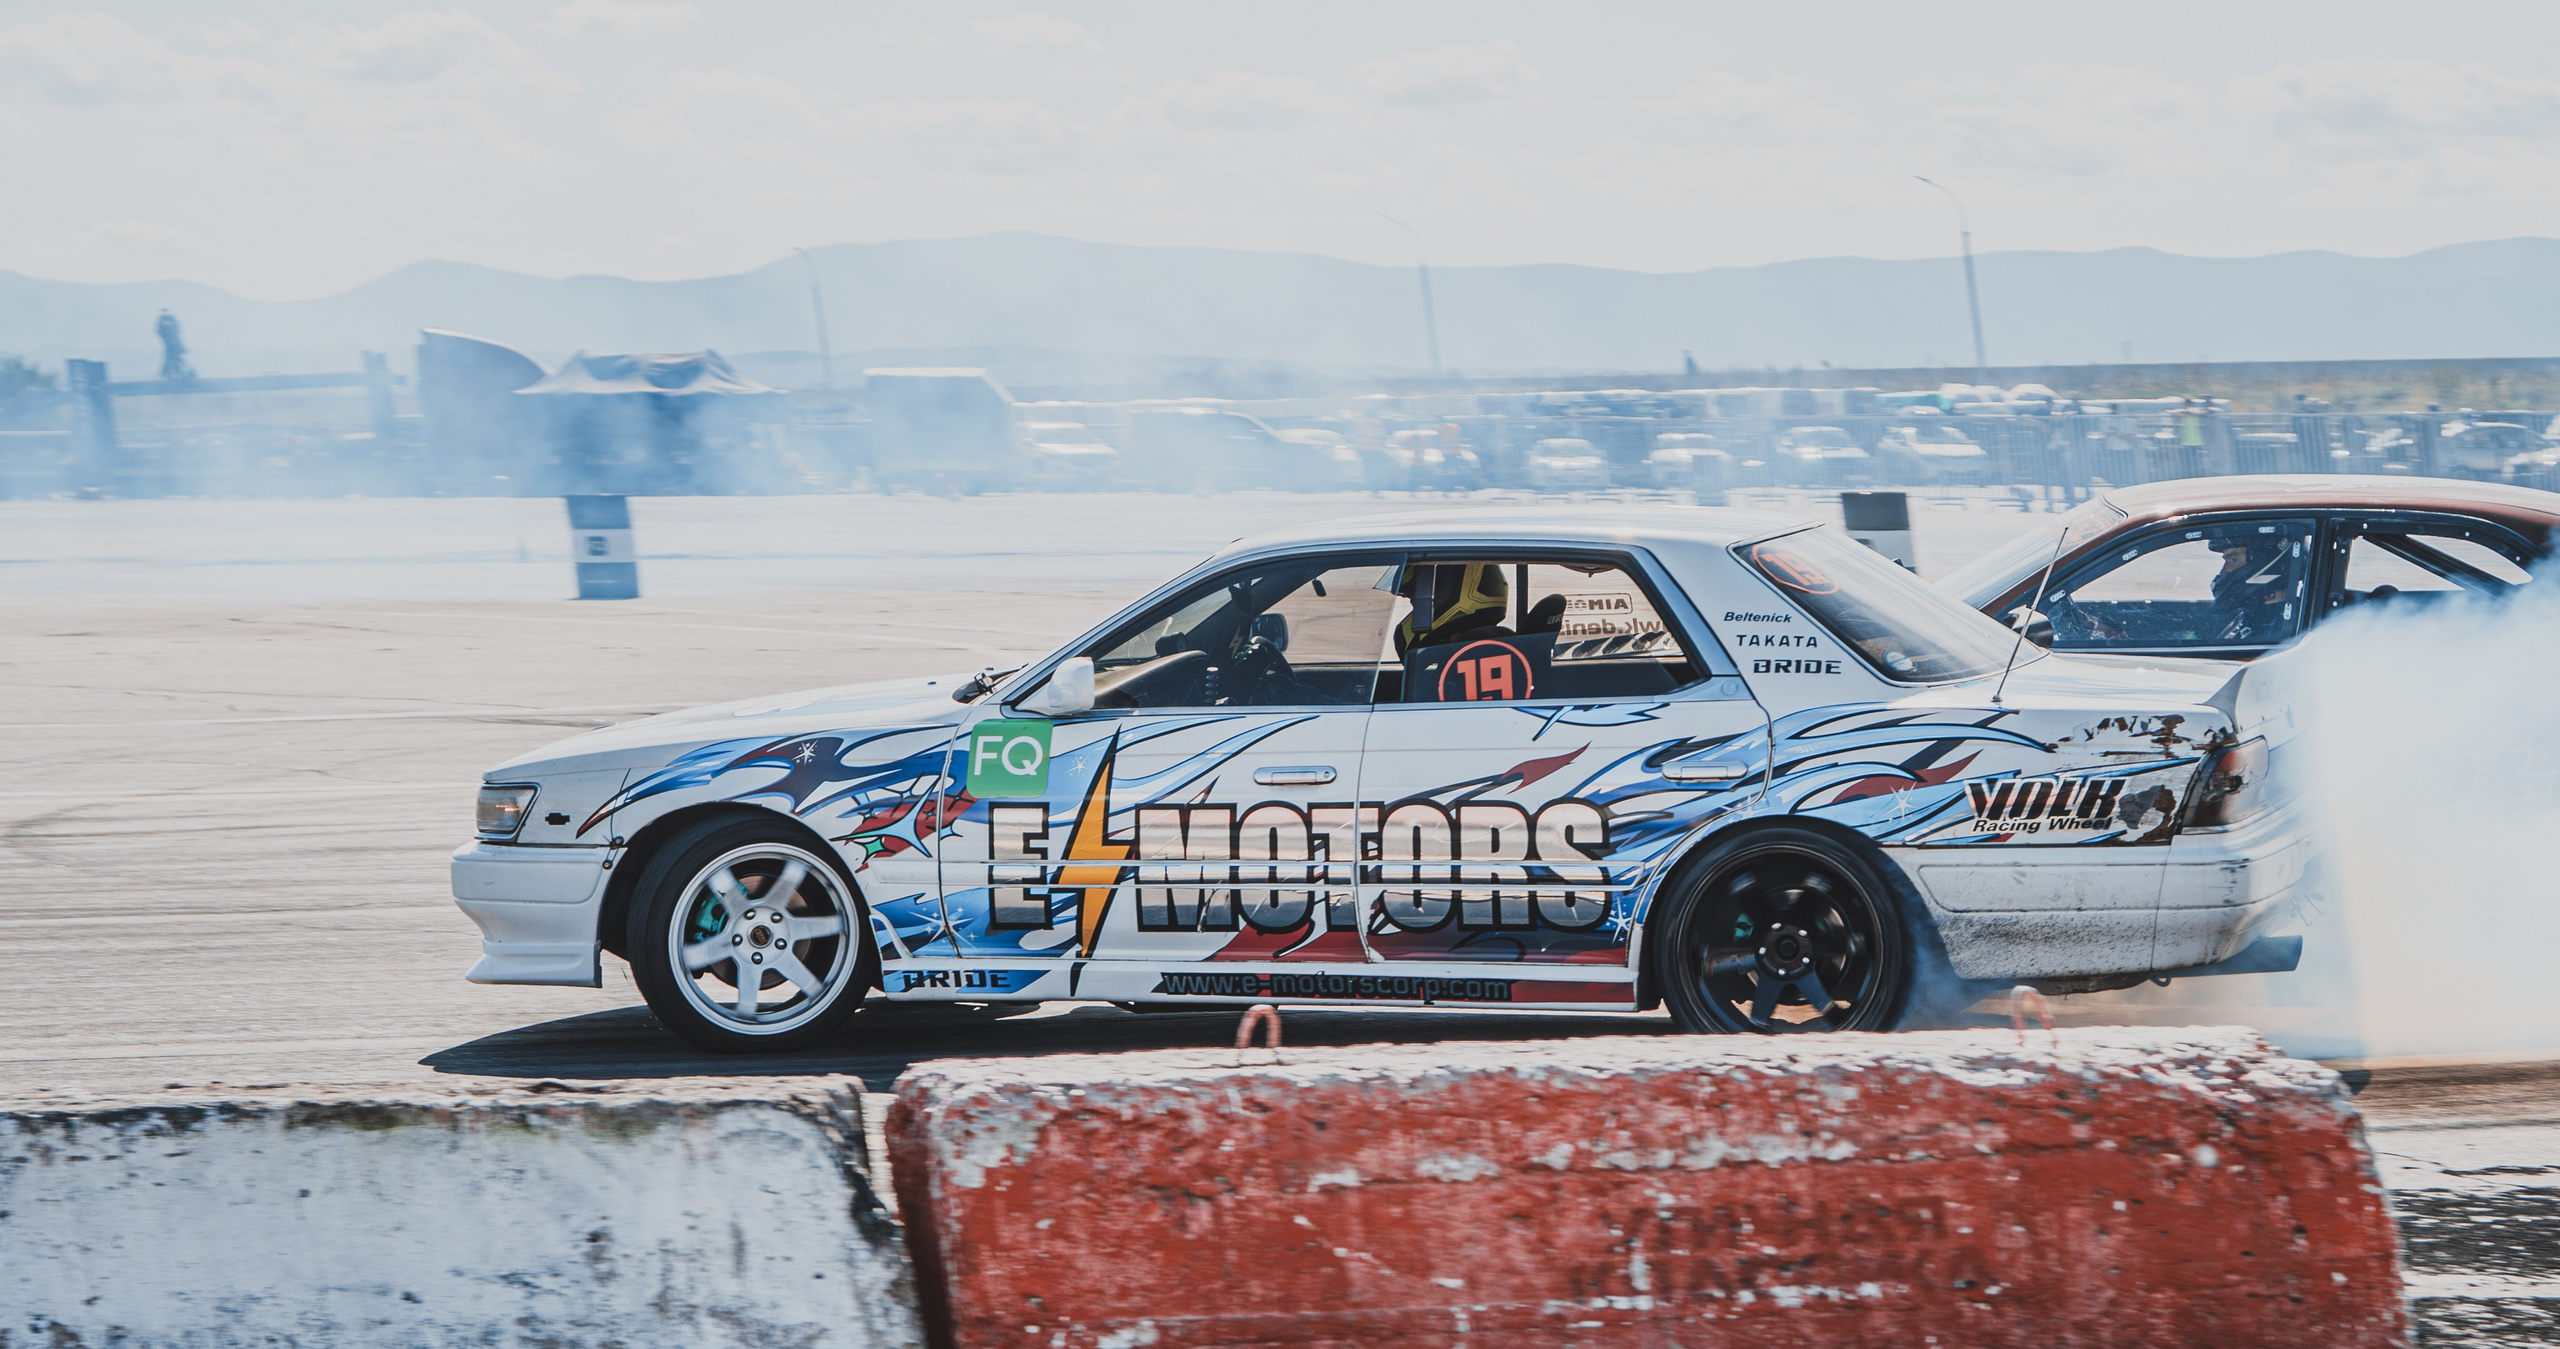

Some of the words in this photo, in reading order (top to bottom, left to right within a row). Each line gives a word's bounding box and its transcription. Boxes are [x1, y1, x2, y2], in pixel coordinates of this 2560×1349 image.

[1760, 552, 1832, 586] 19
[1724, 611, 1792, 623] Beltenick
[1736, 635, 1818, 648] TAKATA
[1457, 654, 1513, 700] 19
[1753, 660, 1842, 674] BRIDE
[974, 736, 1043, 776] FQ
[1967, 776, 2128, 822] VOLK
[1972, 819, 2041, 834] Racing
[2049, 817, 2112, 831] Wheel
[1135, 800, 1612, 934] MOTORS
[902, 970, 1011, 988] BRIDE
